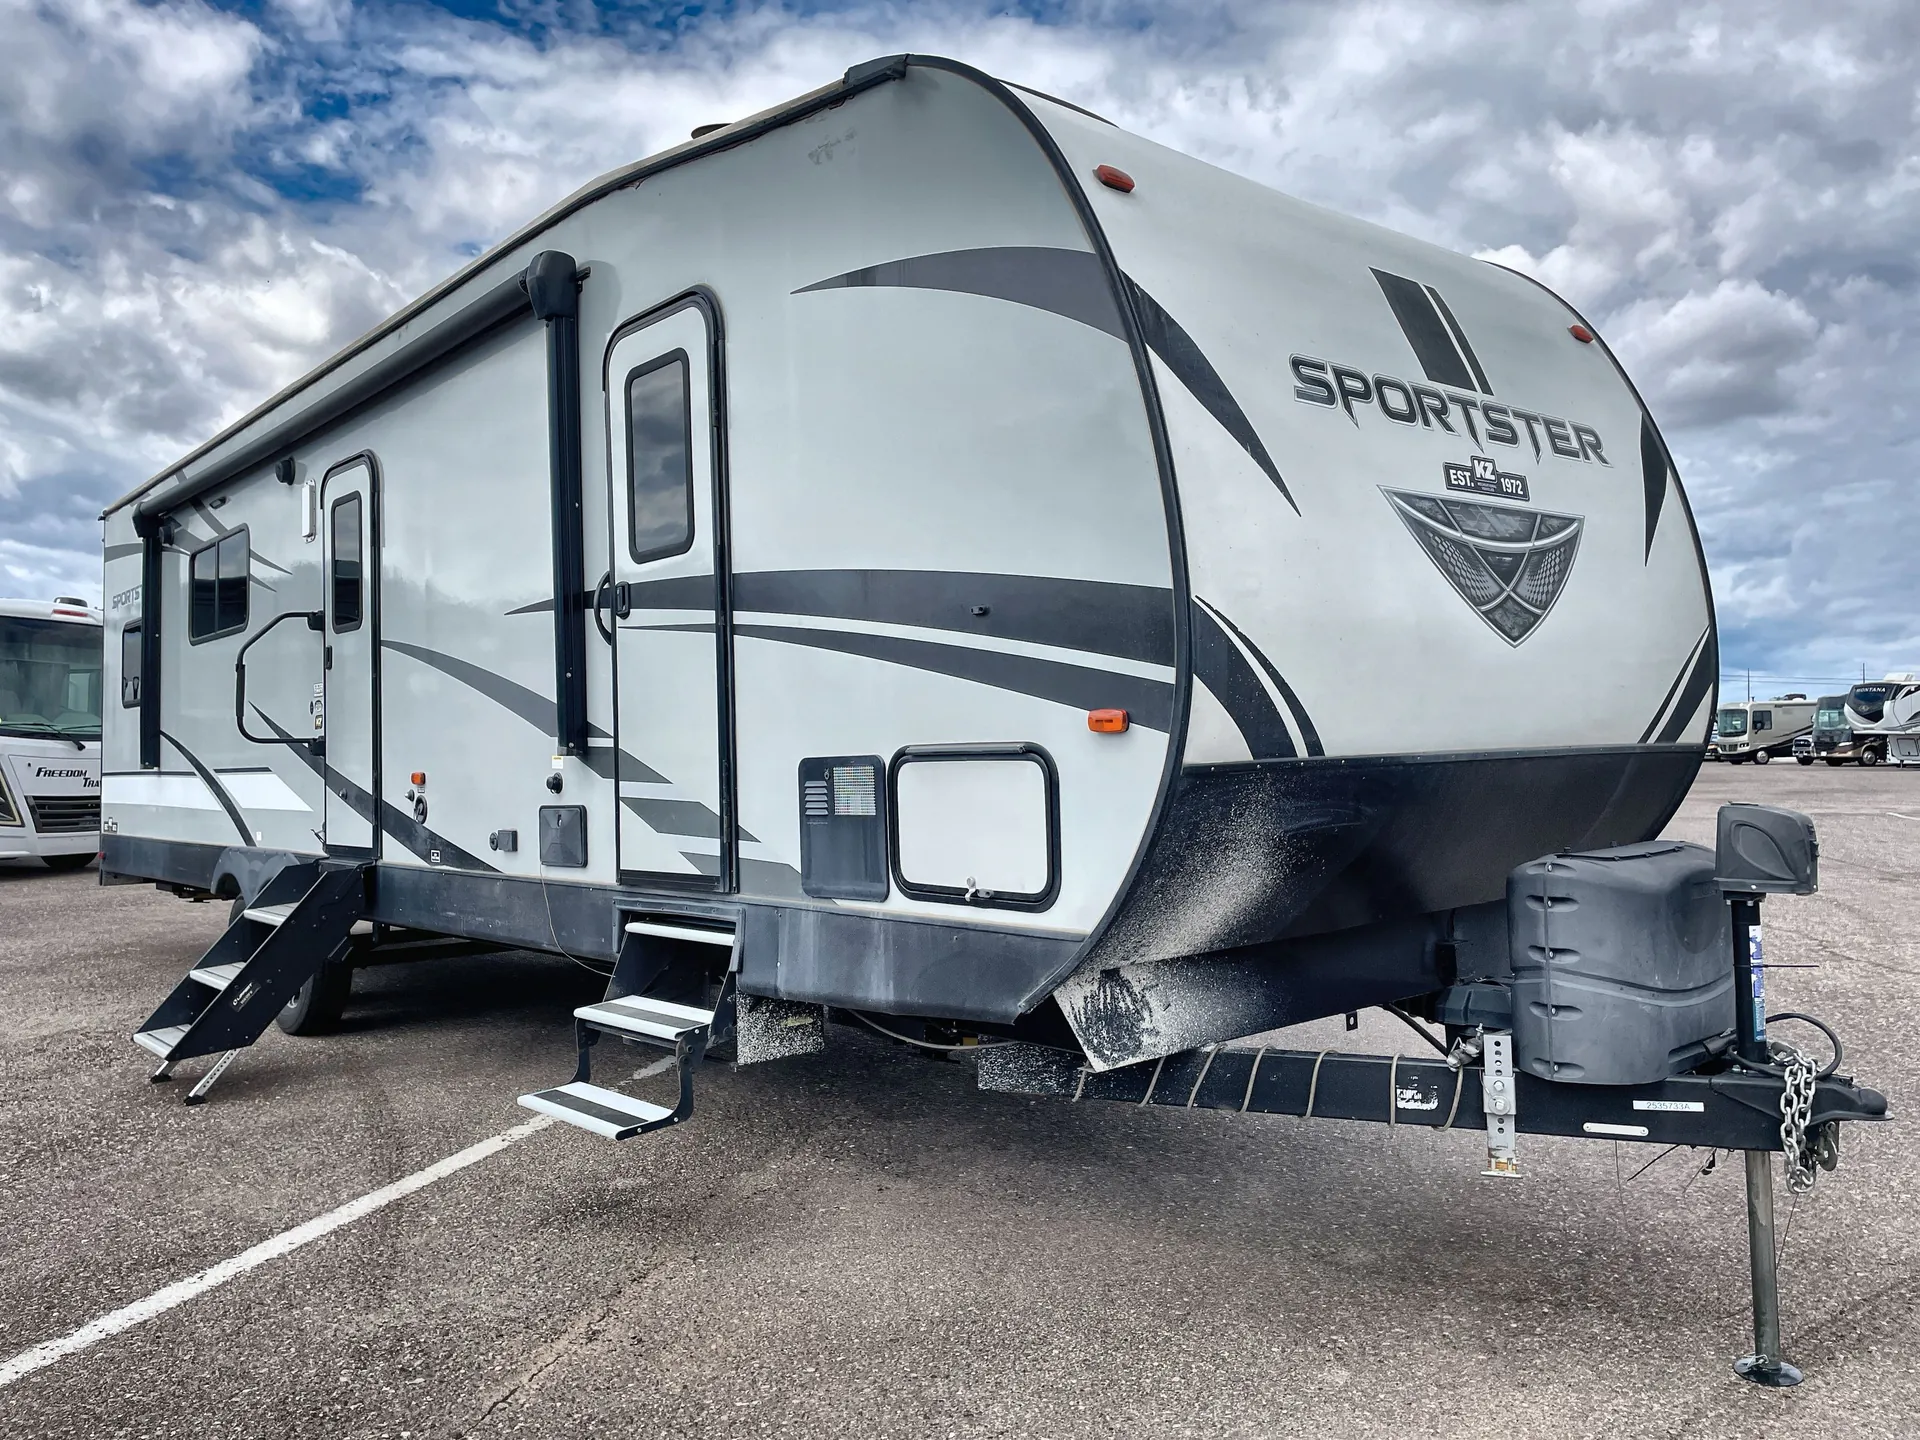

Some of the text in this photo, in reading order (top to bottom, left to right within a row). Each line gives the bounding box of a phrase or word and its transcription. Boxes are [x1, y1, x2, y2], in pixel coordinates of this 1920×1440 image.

[1289, 353, 1613, 467] SPORTSTER
[1449, 469, 1475, 488] EST.
[1500, 477, 1524, 495] 1972
[1473, 459, 1496, 481] KZ
[111, 584, 142, 612] SPORTS
[35, 766, 88, 778] FREEDOM
[83, 777, 101, 788] TRA
